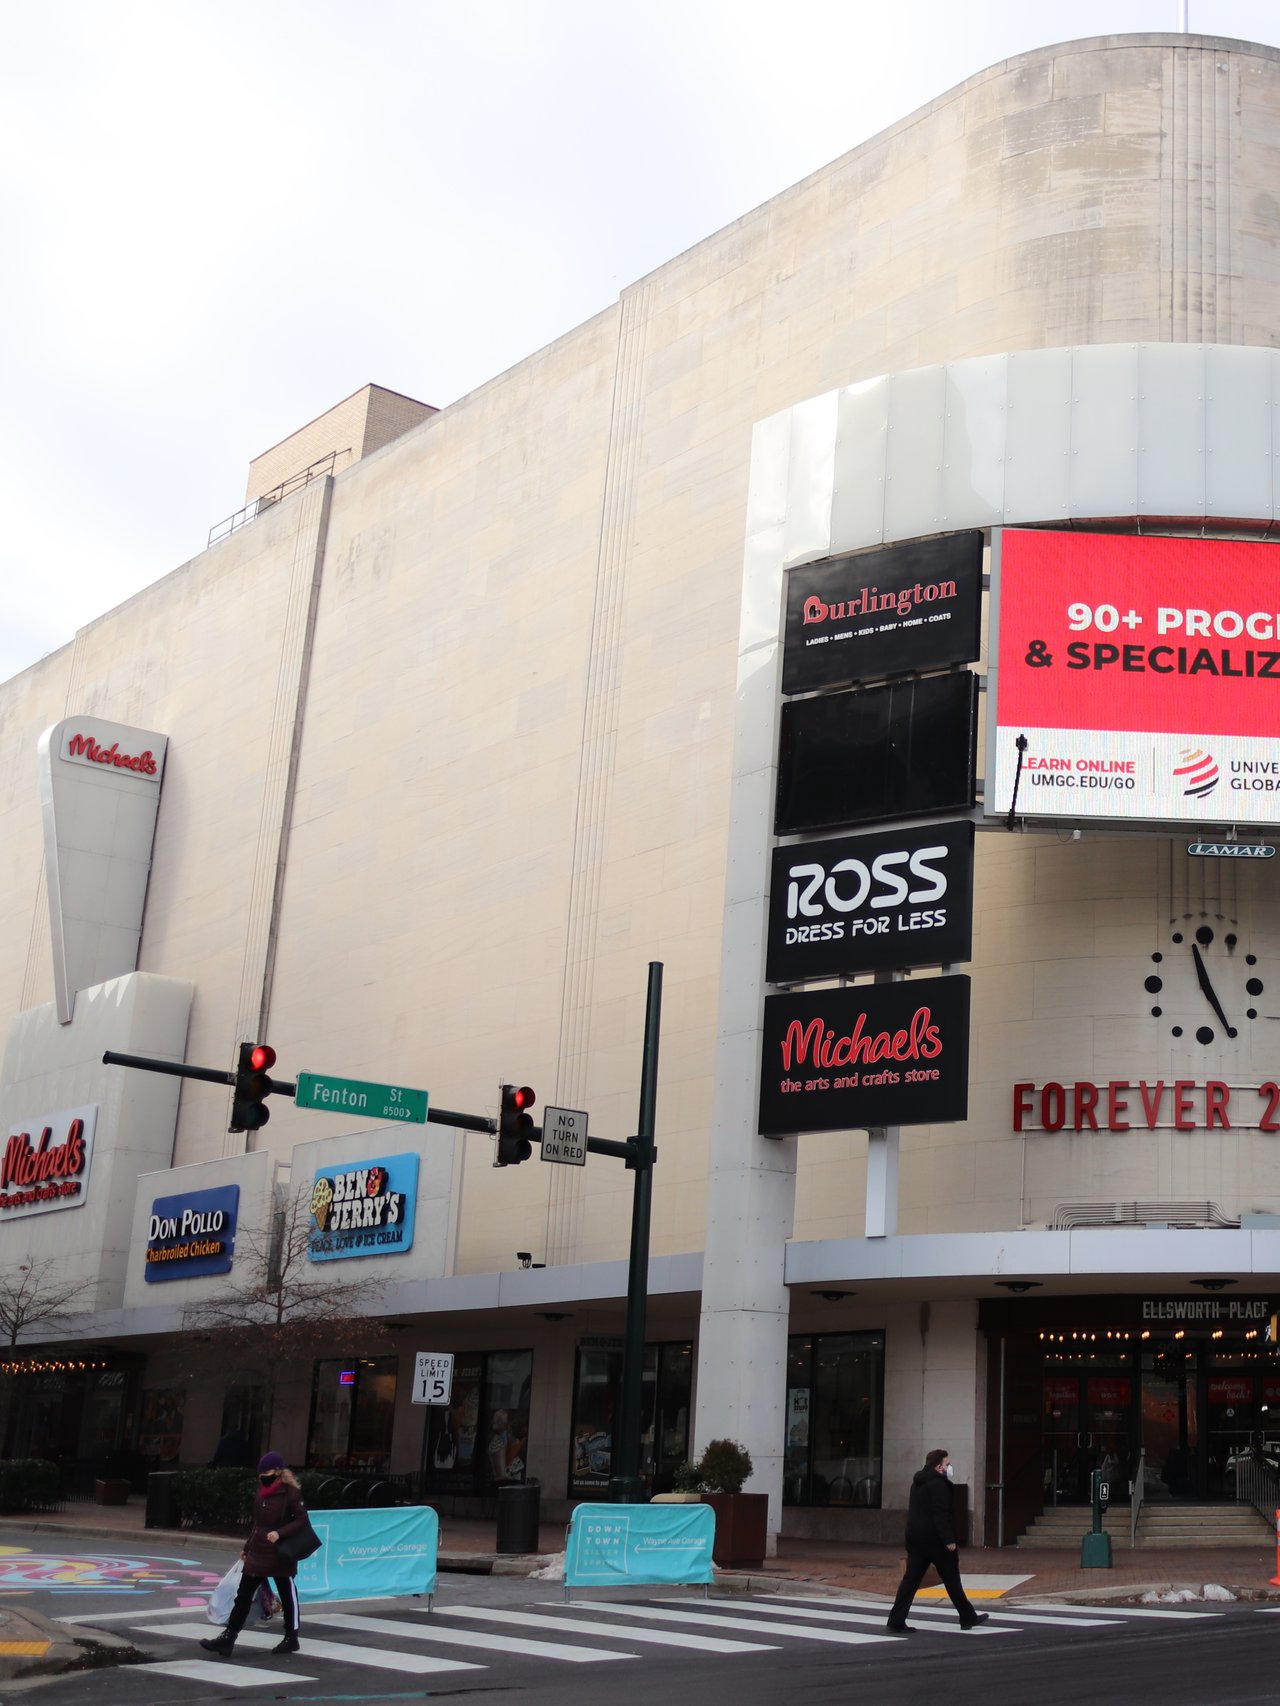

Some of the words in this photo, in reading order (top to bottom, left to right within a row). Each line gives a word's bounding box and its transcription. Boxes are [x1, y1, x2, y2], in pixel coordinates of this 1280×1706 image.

[803, 580, 957, 625] Burlington
[1067, 602, 1142, 633] 90+
[806, 636, 829, 646] LADIES
[834, 631, 853, 641] MENS
[858, 627, 874, 636] KIDS
[880, 623, 897, 632] BABY
[903, 617, 923, 628] HOME
[929, 612, 952, 623] COATS
[1025, 639, 1053, 668] &
[69, 733, 157, 775] Michaels
[1075, 760, 1135, 773] ONLINE
[1032, 774, 1135, 789] UMGC.EDU/GO
[1195, 845, 1267, 856] LAMAR
[787, 846, 948, 919] ROSS
[786, 921, 845, 945] DRESS
[852, 916, 889, 936] FOR
[898, 909, 946, 931] LESS
[781, 1007, 943, 1071] Michaels
[781, 1078, 801, 1093] the
[805, 1077, 829, 1090] arts
[834, 1073, 858, 1087] and
[862, 1069, 899, 1084] crafts
[905, 1068, 939, 1082] store
[313, 1083, 367, 1108] Fenton
[390, 1088, 403, 1103] St
[383, 1105, 405, 1118] 8500
[1013, 1080, 1231, 1132] FOREVER
[558, 1116, 574, 1127] NO
[553, 1129, 578, 1143] TURN
[1, 1118, 86, 1189] Michaels
[546, 1144, 559, 1155] ON
[564, 1146, 582, 1158] RED
[330, 1192, 400, 1231] JERRY'S
[377, 1230, 403, 1244] CREAM
[146, 1243, 190, 1262] Charbroiled
[190, 1239, 220, 1257] Chicken
[1142, 1302, 1219, 1319] ELLSWORTH
[1229, 1301, 1268, 1319] PLACE
[419, 1359, 449, 1368] SPEED
[421, 1370, 445, 1378] LIMIT
[422, 1380, 444, 1398] 15
[587, 1525, 621, 1533] DOWN
[348, 1545, 378, 1555] Wayne
[397, 1543, 427, 1554] Garage
[643, 1537, 667, 1546] Wayne
